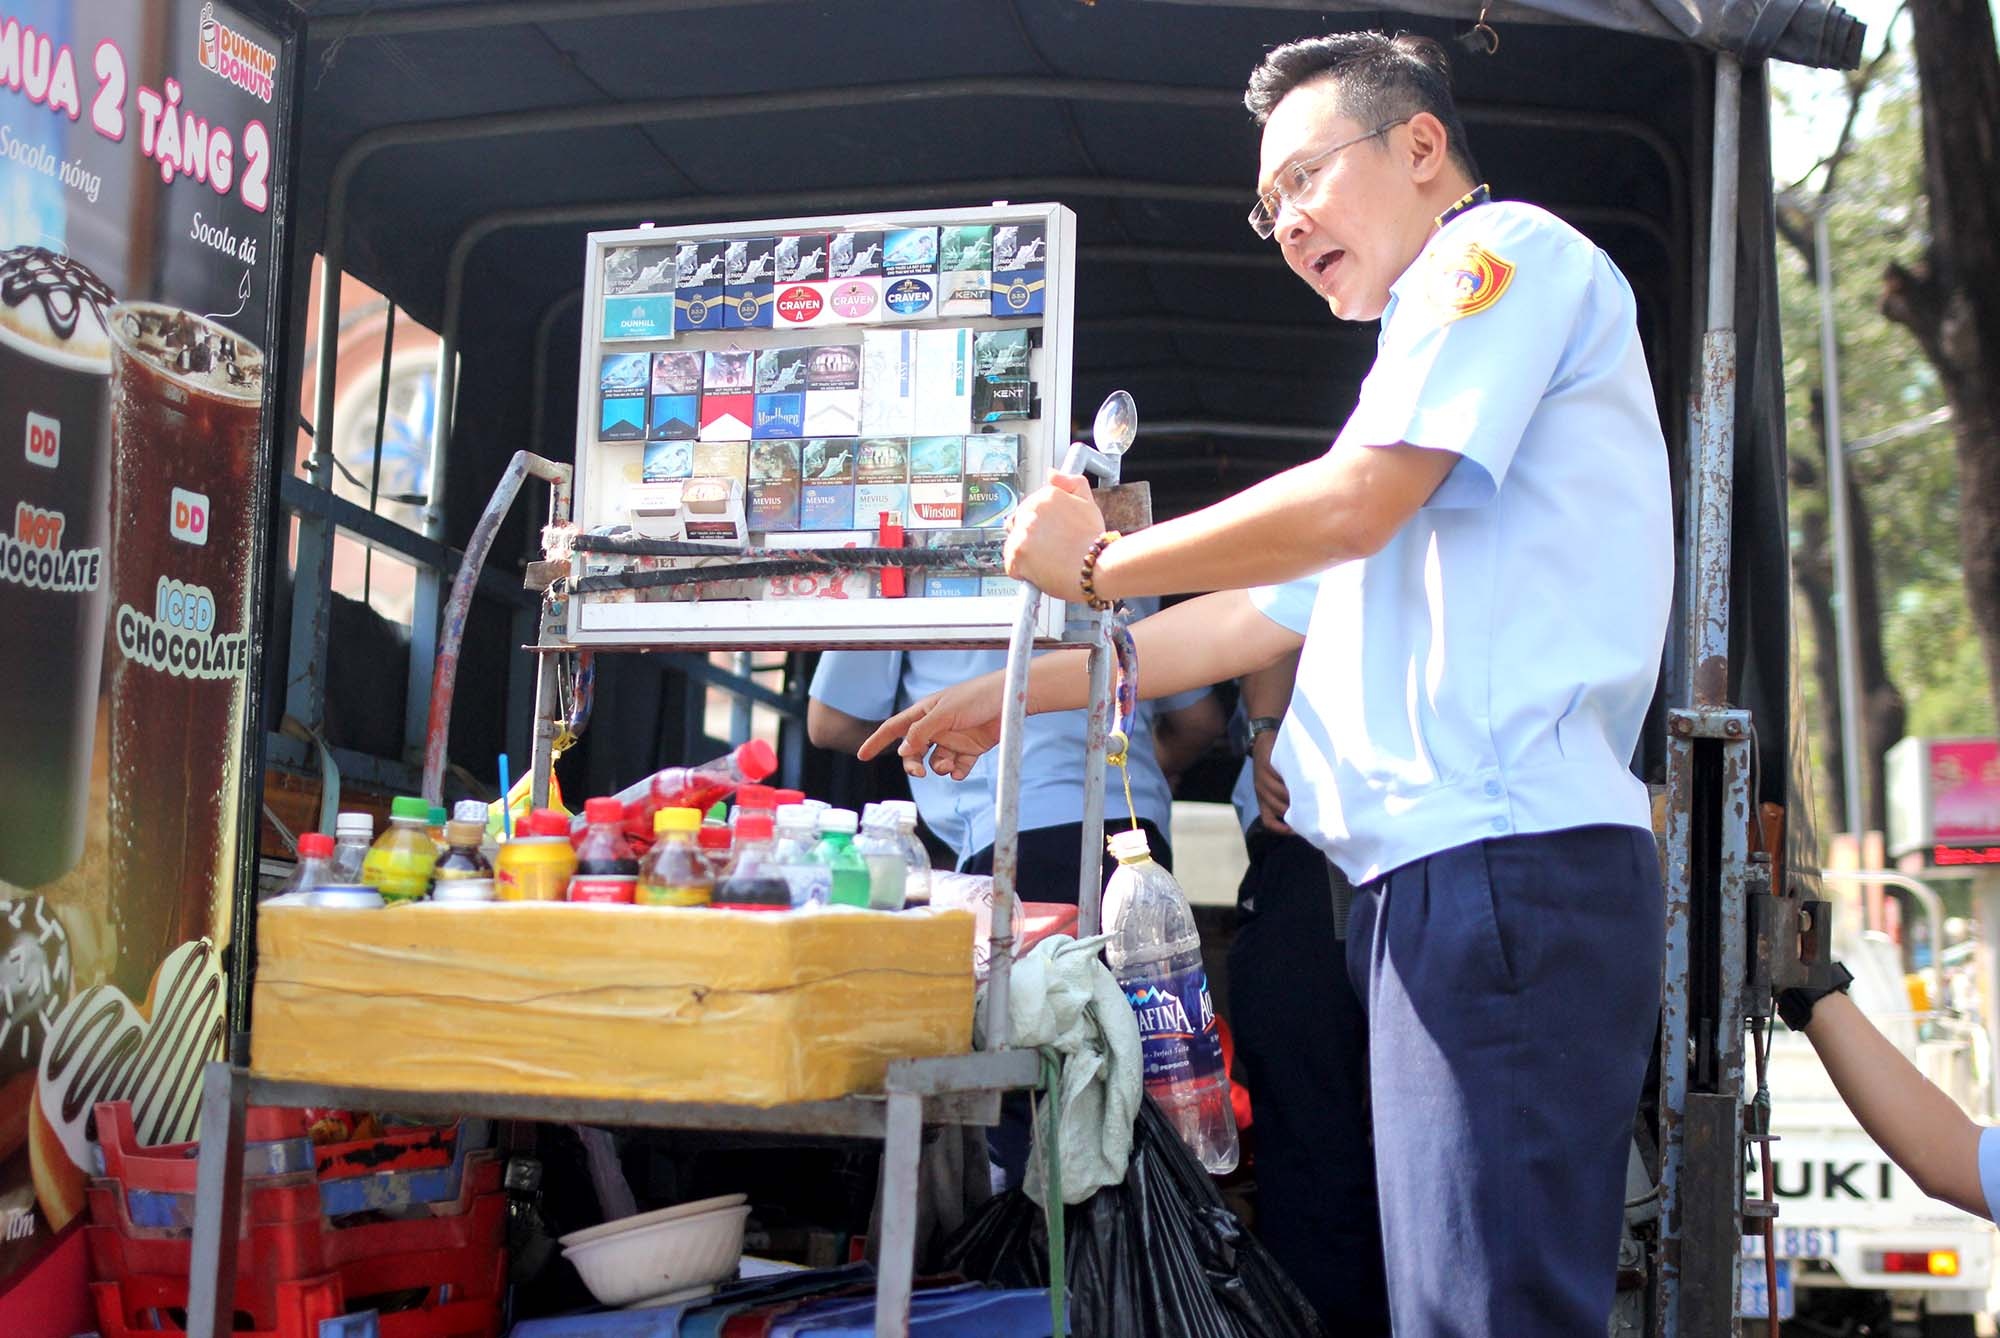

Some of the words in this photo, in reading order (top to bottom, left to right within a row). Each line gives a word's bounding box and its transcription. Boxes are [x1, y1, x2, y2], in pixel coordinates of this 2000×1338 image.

[221, 27, 276, 79] DUNKIN'
[220, 53, 272, 103] DONUTS
[91, 37, 128, 141] 2
[136, 78, 233, 194] TẶNG
[240, 120, 270, 213] 2
[0, 126, 56, 177] Socola
[59, 159, 101, 203] nóng
[190, 212, 236, 256] Socola
[238, 237, 258, 265] đá
[834, 295, 874, 306] CRAVEN
[888, 292, 930, 303] CRAVEN
[955, 290, 985, 299] KENT
[779, 300, 820, 311] CRAVEN
[795, 311, 804, 320] A
[621, 320, 655, 328] DUNHILL
[993, 389, 1024, 398] KENT
[758, 407, 800, 428] Marlboro
[30, 425, 56, 457] DD
[753, 497, 782, 505] MEVIUS
[806, 496, 835, 504] MEVIUS
[860, 495, 889, 503] MEVIUS
[968, 493, 999, 502] MEVIUS
[175, 501, 205, 533] DD
[922, 504, 957, 518] Winston
[159, 585, 212, 632] ICED
[120, 613, 247, 672] CHOCOLATE
[1134, 996, 1194, 1034] AFINA
